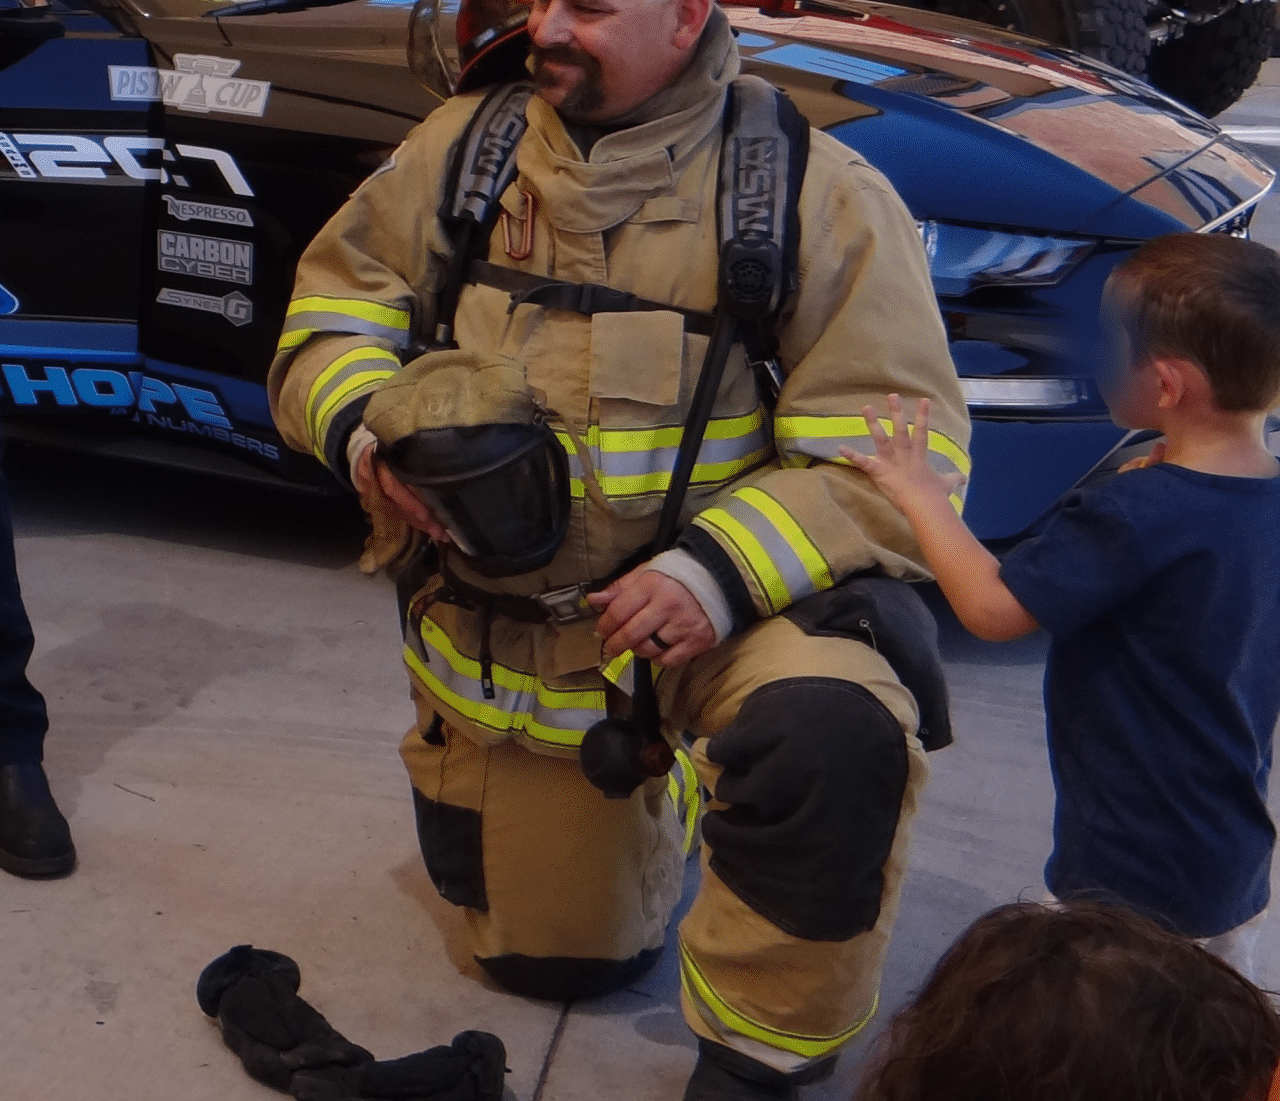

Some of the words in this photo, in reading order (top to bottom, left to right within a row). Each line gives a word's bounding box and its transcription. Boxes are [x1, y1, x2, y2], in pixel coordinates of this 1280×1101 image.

[117, 70, 183, 100] PISTN
[214, 82, 261, 109] CUP
[477, 96, 523, 173] MSA
[738, 140, 771, 232] MSA
[162, 197, 247, 223] NESPRESSO
[160, 233, 250, 268] CARBON
[161, 257, 250, 283] CYBER
[2, 363, 233, 430] HOPE
[146, 413, 280, 460] NUMBERS
